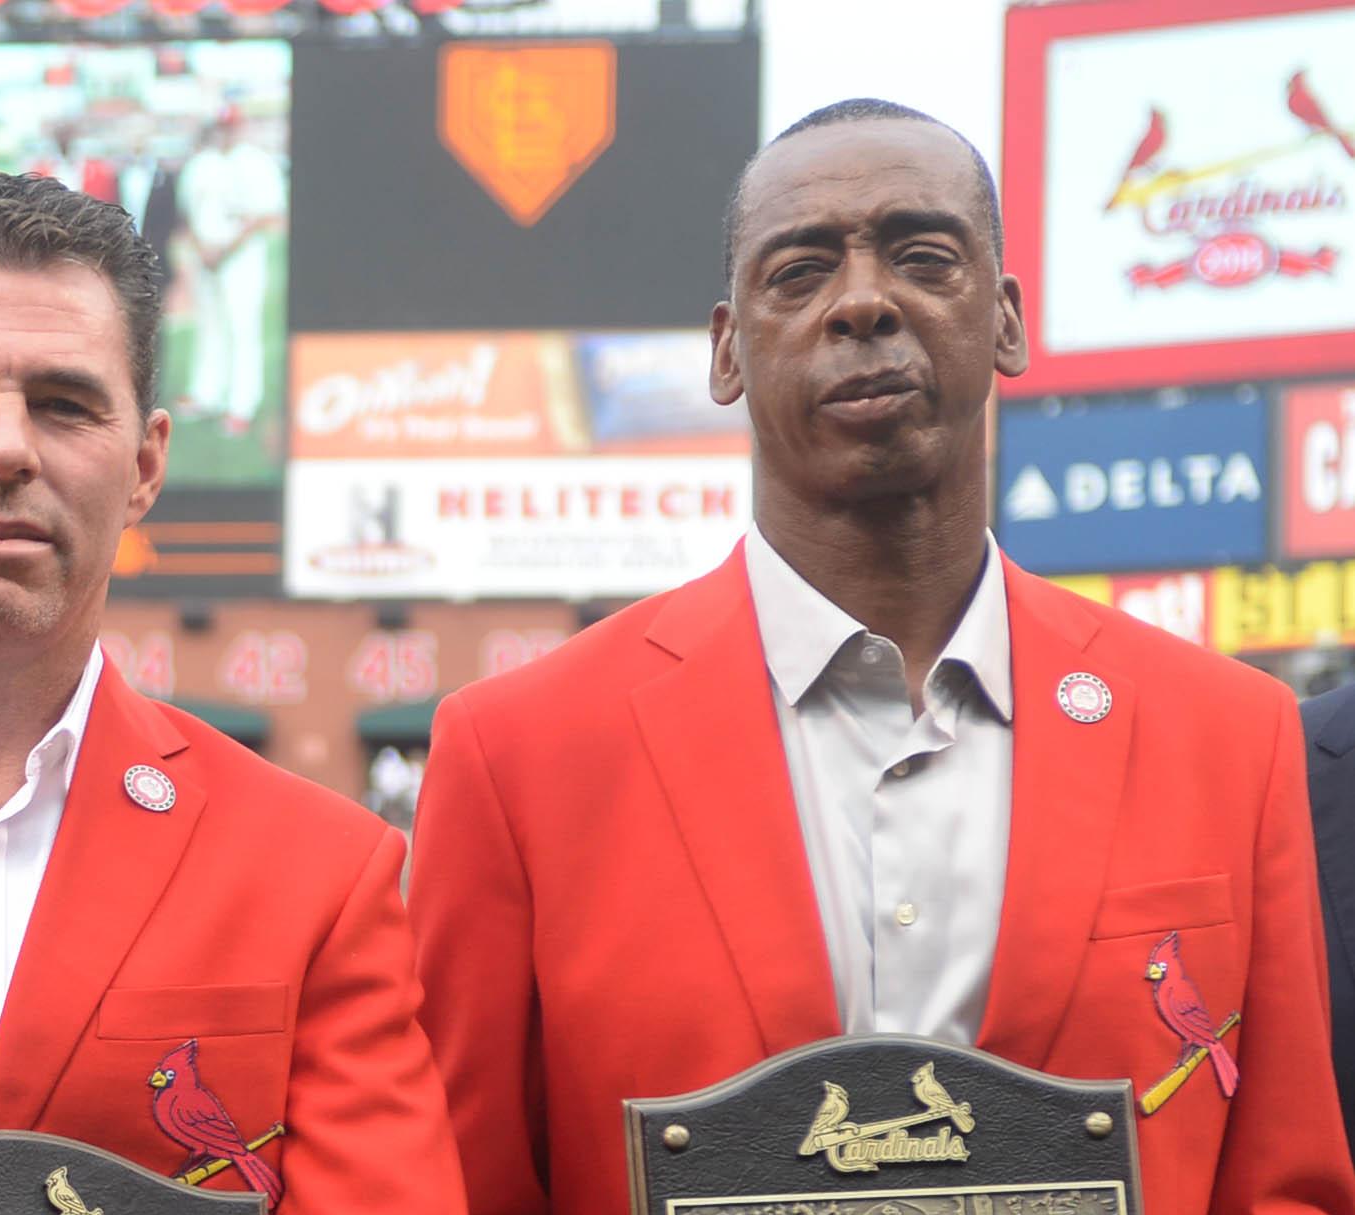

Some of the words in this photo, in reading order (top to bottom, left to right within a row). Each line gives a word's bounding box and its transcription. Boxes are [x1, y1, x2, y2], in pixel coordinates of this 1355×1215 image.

[1143, 174, 1345, 234] Cardinals
[437, 486, 734, 519] HELITECH
[1065, 453, 1261, 513] DELTA
[224, 632, 307, 701] 42
[349, 632, 437, 701] 45
[825, 1126, 971, 1172] Cardinals
